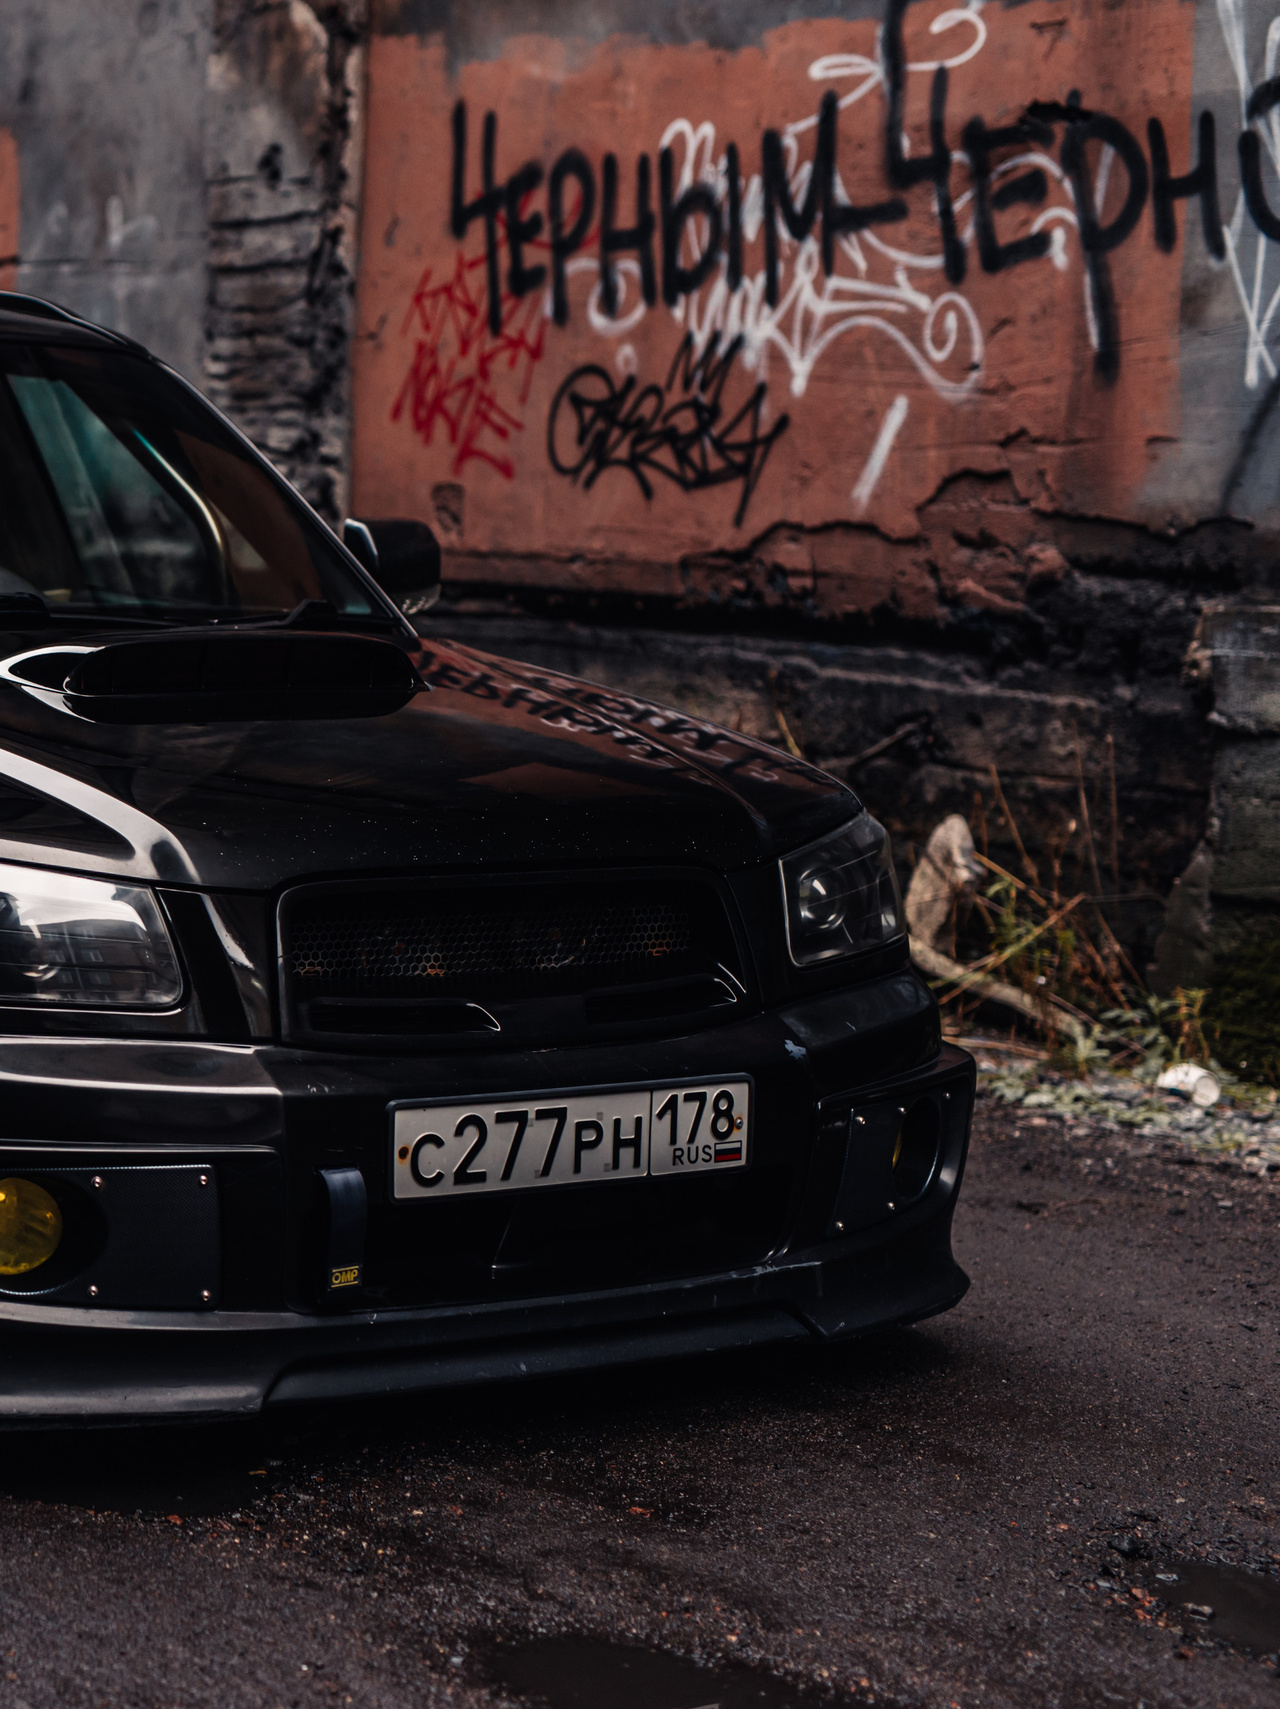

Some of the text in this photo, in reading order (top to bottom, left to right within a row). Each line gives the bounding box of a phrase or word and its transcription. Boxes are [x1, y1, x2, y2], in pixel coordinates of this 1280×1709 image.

[655, 1089, 735, 1146] 178
[672, 1144, 713, 1166] RUS
[332, 1269, 358, 1284] OMP
